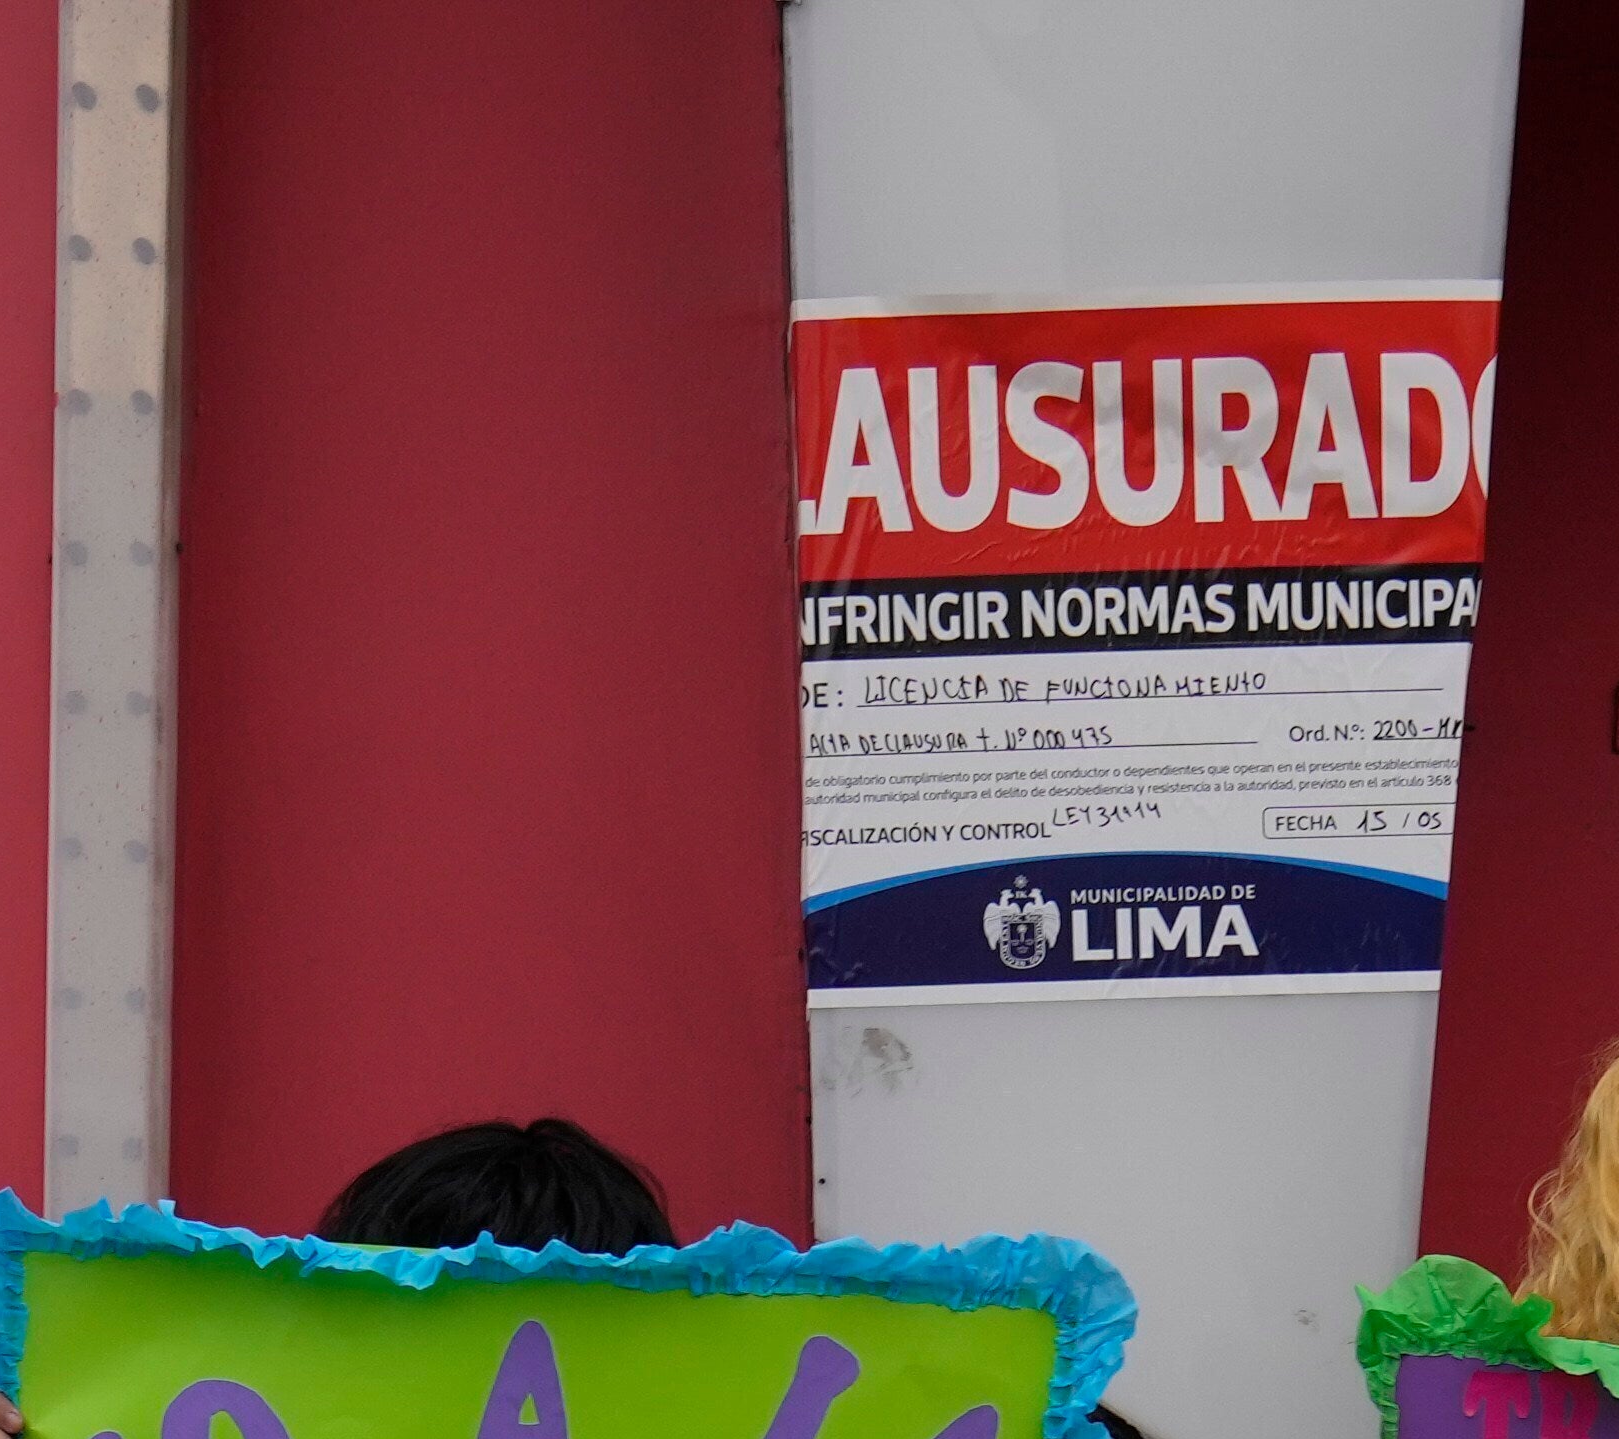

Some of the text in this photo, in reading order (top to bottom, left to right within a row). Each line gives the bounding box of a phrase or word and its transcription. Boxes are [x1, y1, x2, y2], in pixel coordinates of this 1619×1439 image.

[798, 352, 1497, 535] AUSURAD
[1021, 583, 1233, 640] NORMAS
[1289, 725, 1329, 742] Ord.
[943, 825, 954, 842] Y
[960, 822, 1052, 841] CONTROL
[1275, 815, 1337, 831] FECHA
[1357, 810, 1387, 833] 15
[1071, 884, 1256, 905] MUNICIPALIDAD DE
[1071, 906, 1260, 962] LIMA
